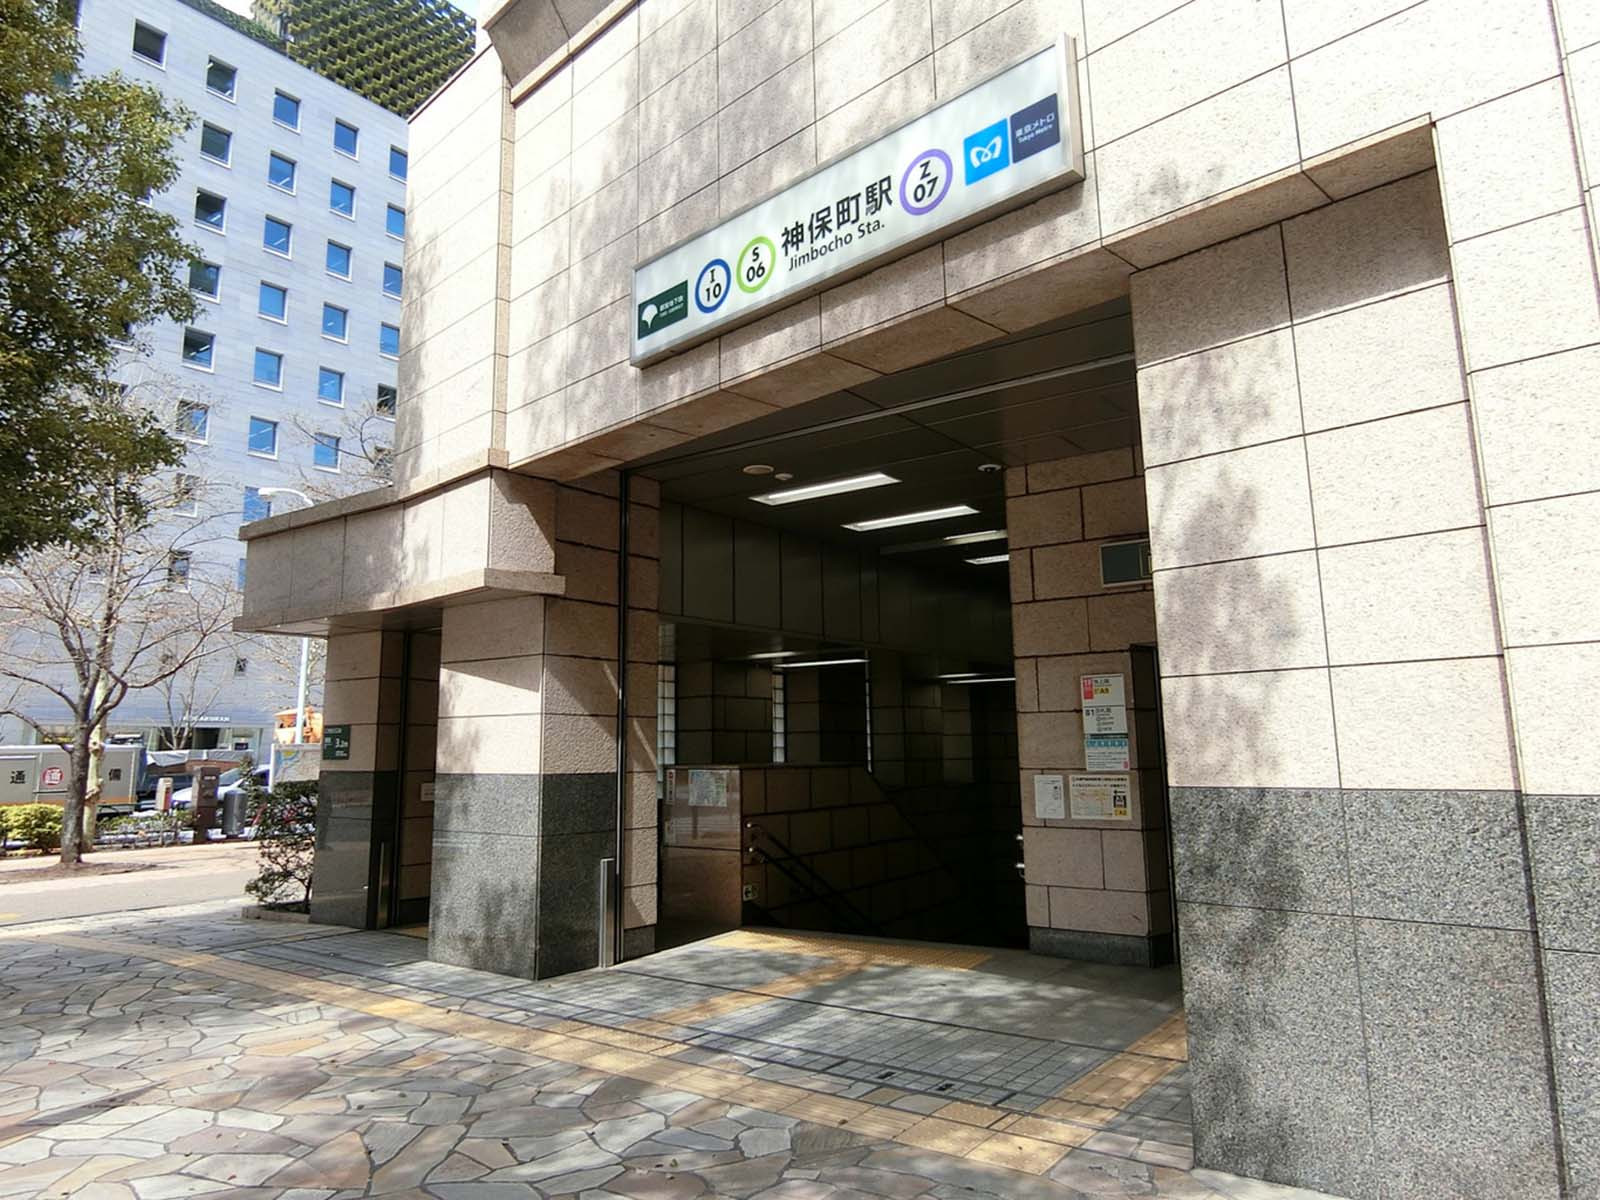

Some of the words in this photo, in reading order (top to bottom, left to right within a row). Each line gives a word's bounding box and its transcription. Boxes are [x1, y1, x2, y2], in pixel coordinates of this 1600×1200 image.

[1015, 113, 1055, 137] 東京メトロ
[919, 160, 931, 180] Z
[913, 176, 938, 203] 07
[781, 175, 893, 257] 神保町駅
[752, 246, 760, 262] S
[789, 233, 853, 272] Jimbocho
[857, 219, 885, 239] Sta.
[709, 268, 716, 284] I
[746, 262, 765, 282] 06
[705, 283, 722, 302] 10
